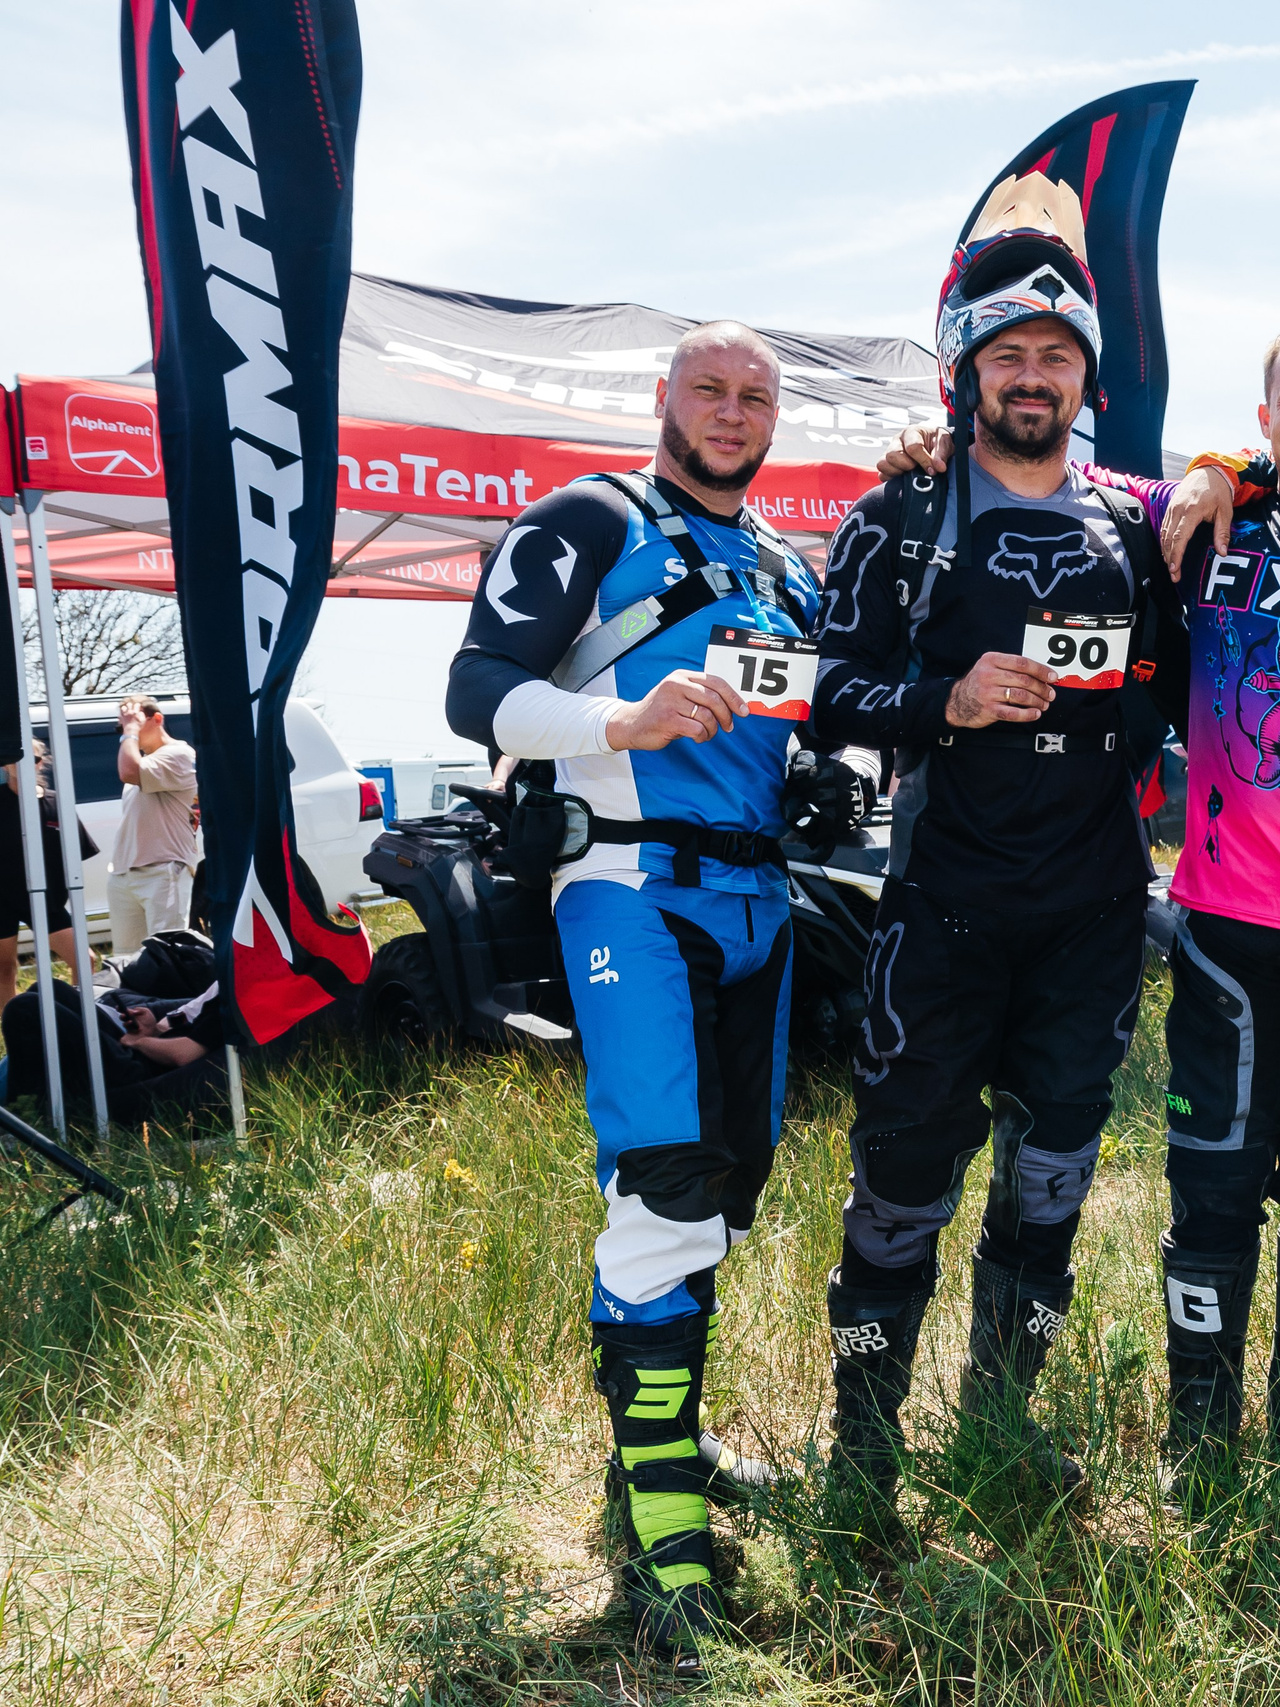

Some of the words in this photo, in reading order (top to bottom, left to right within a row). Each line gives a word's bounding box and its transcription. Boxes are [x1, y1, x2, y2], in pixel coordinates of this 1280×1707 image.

[71, 416, 152, 436] AlphaTent
[743, 495, 798, 518] НЫЕ
[801, 498, 857, 520] ШАТ
[1047, 633, 1109, 670] 90
[738, 654, 789, 696] 15
[831, 677, 916, 711] FOX
[589, 946, 619, 984] af
[1167, 1276, 1222, 1333] G
